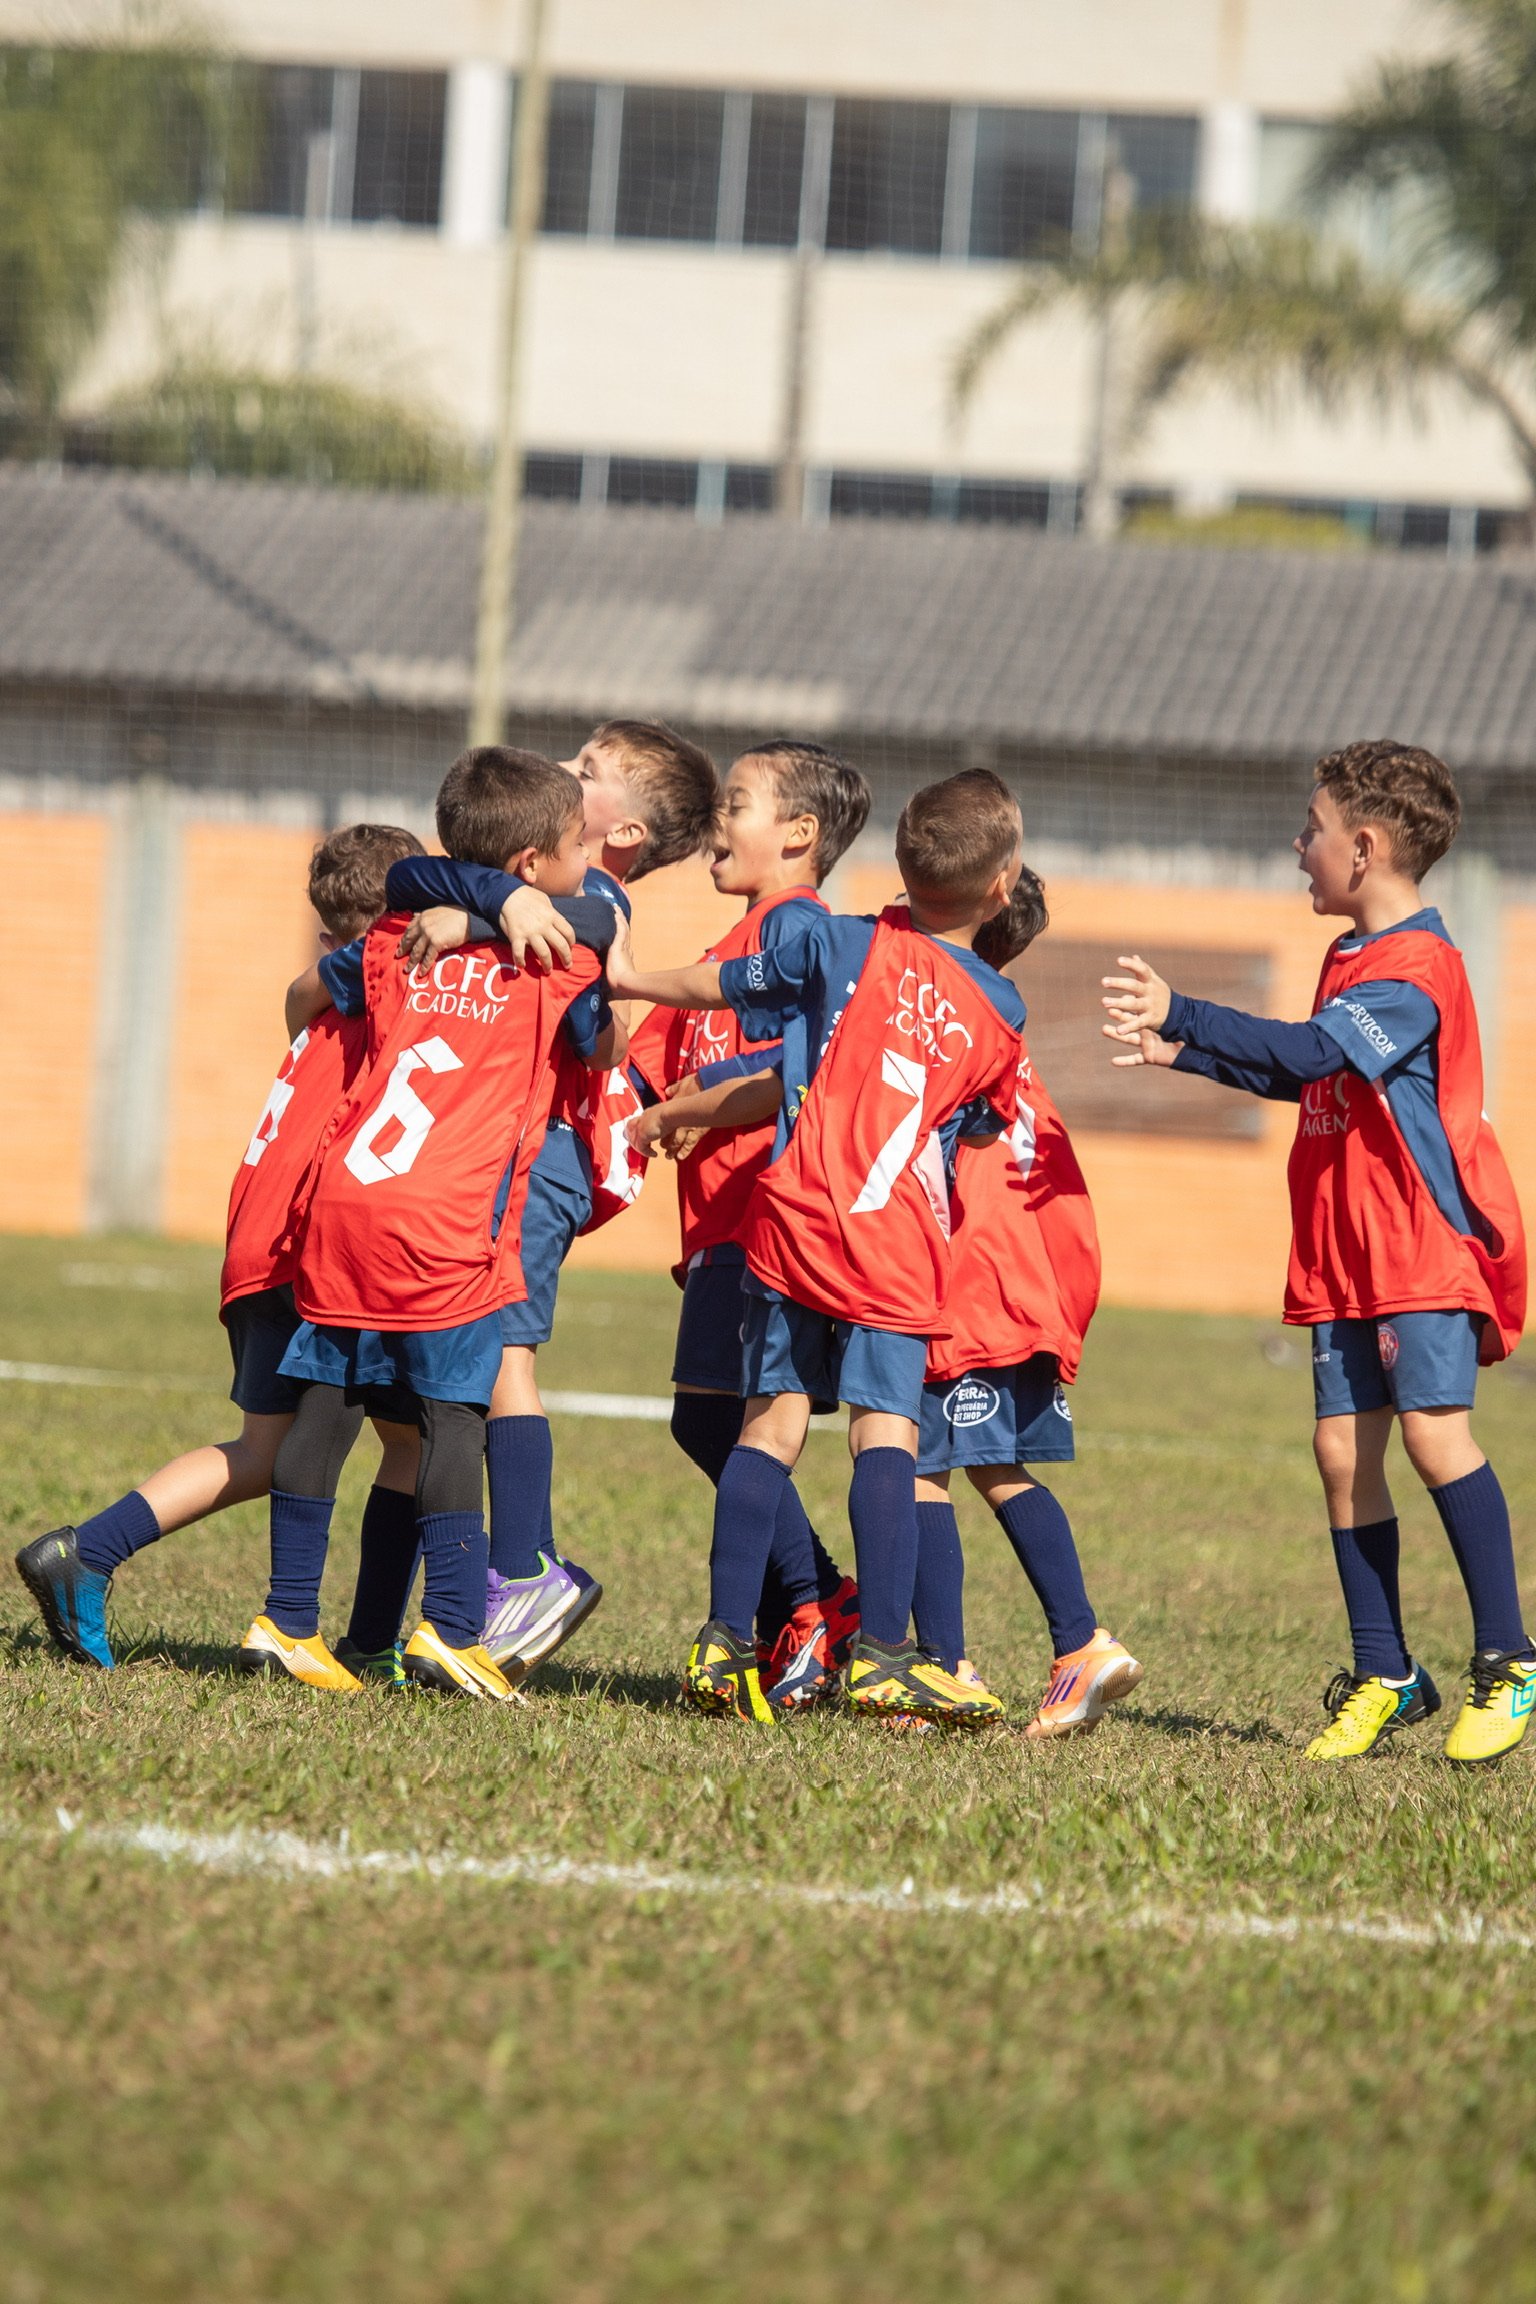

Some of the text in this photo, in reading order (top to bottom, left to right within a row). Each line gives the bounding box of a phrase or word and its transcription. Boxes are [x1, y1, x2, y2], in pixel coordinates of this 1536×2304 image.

[343, 1035, 465, 1186] 6
[848, 1047, 927, 1214] 7
[955, 1386, 990, 1402] ERRA
